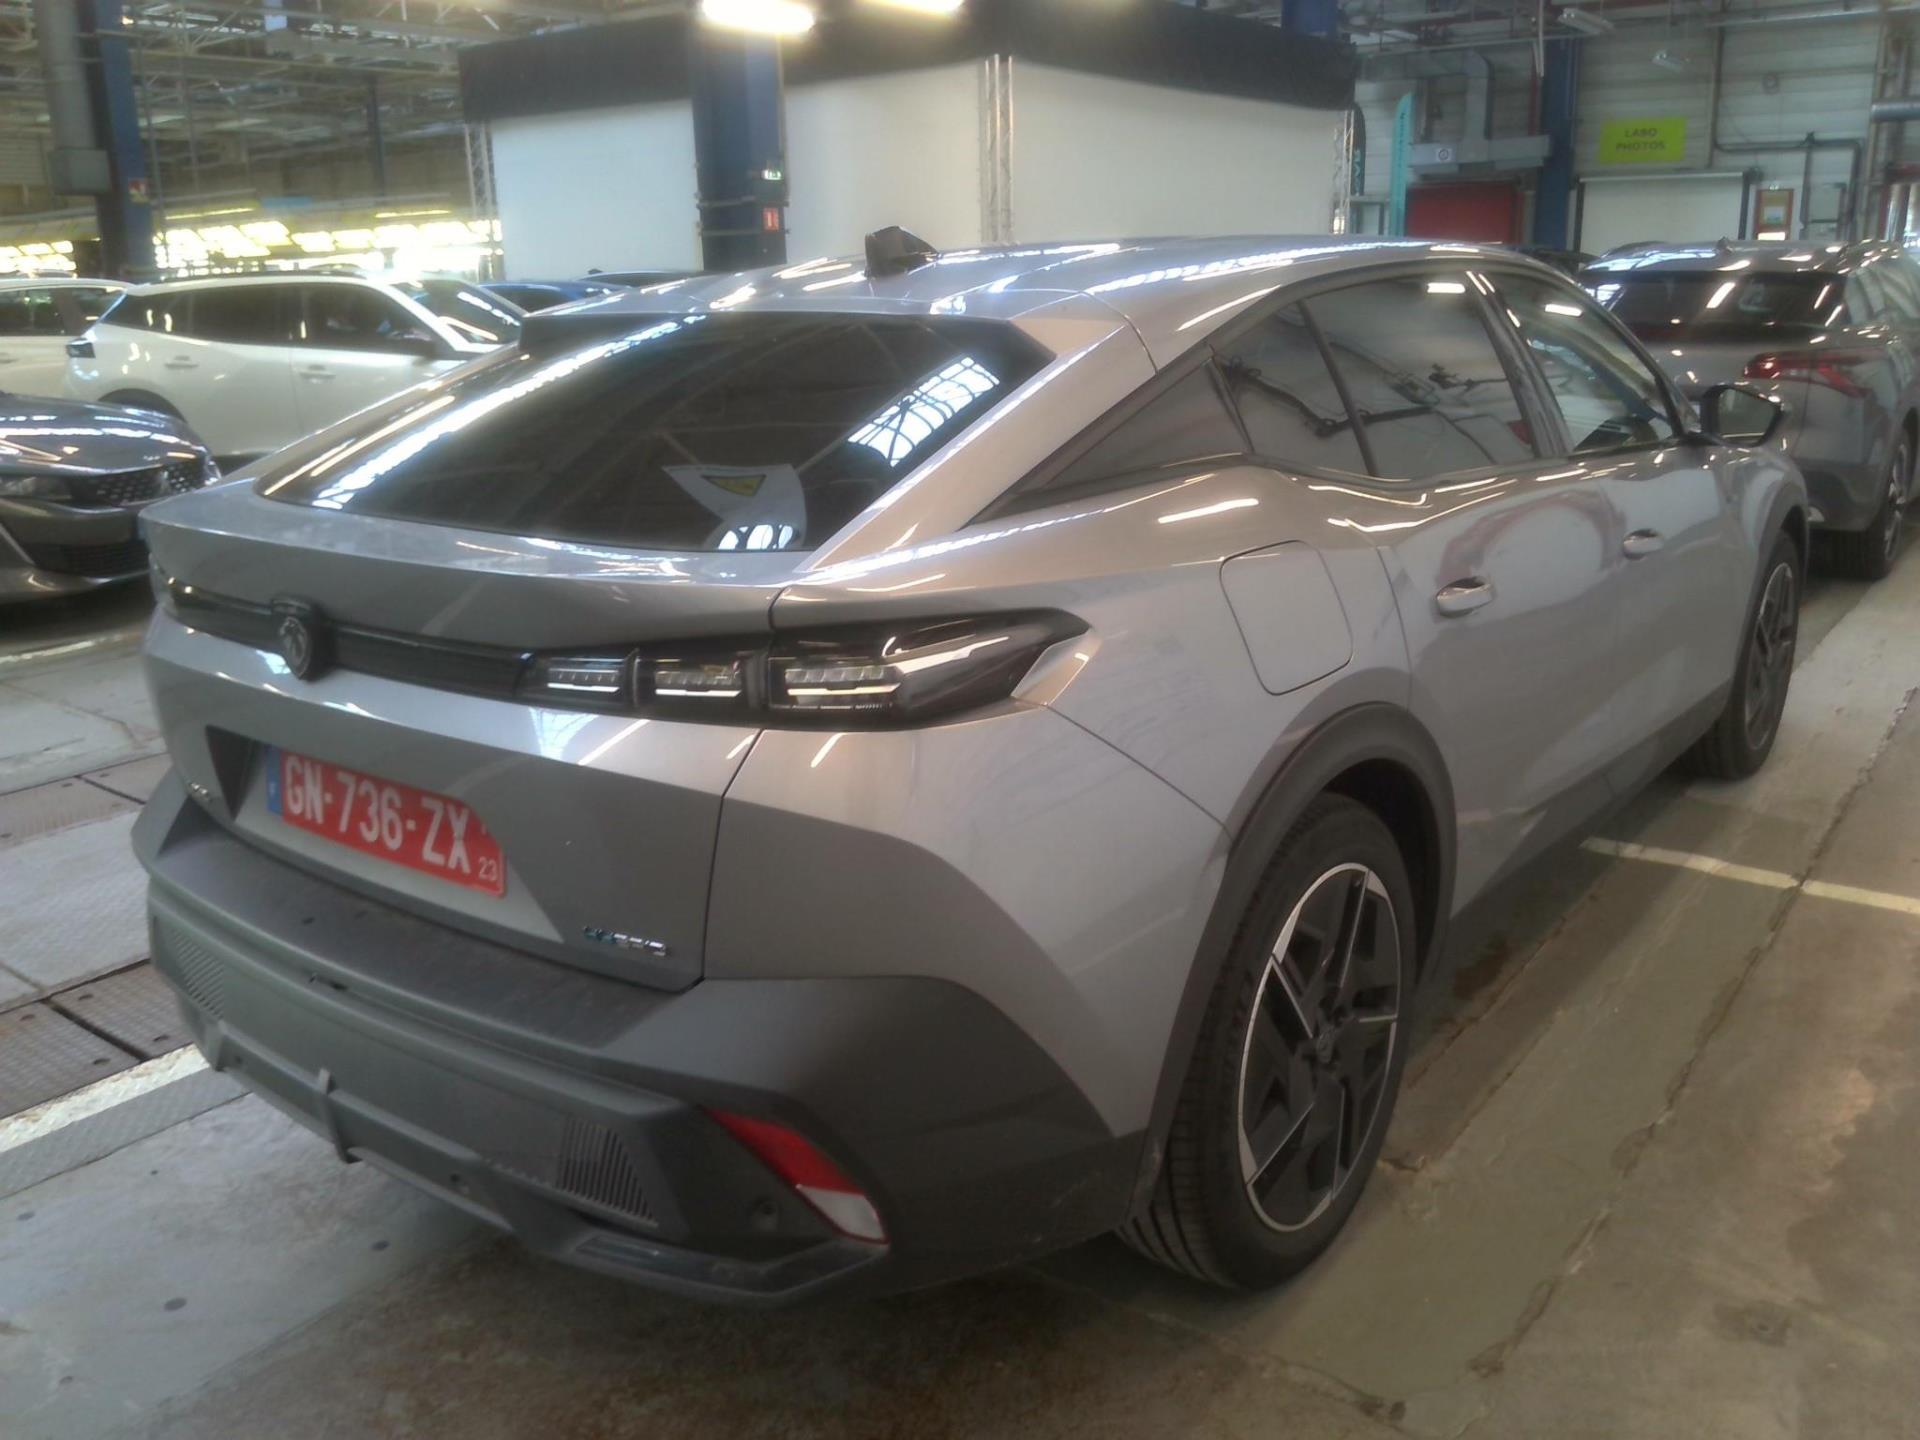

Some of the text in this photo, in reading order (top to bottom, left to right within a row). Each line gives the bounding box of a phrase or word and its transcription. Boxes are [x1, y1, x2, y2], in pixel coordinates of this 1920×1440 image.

[1624, 127, 1658, 138] LABO
[1615, 140, 1666, 151] PHOTOS
[285, 755, 470, 875] GN-736-ZX
[478, 856, 498, 882] 23
